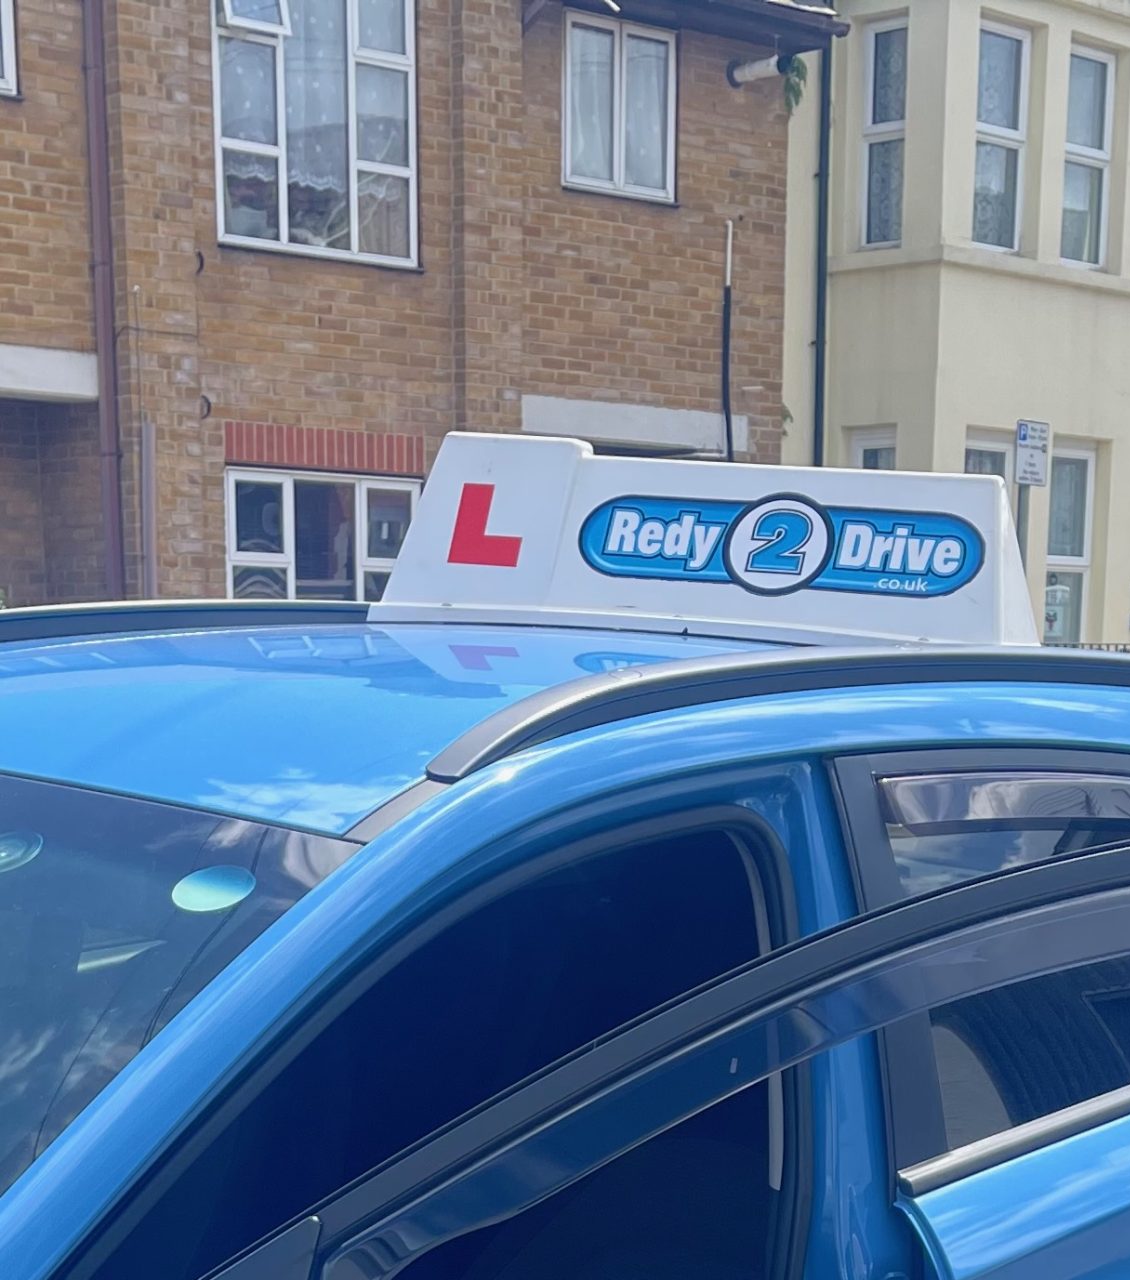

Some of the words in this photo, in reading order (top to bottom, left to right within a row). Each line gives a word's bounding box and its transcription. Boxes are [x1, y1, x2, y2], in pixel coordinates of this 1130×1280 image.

[447, 483, 523, 567] L
[605, 508, 724, 569] Redy
[744, 508, 814, 575] 2
[837, 522, 963, 576] Drive
[873, 577, 928, 592] .co.uk
